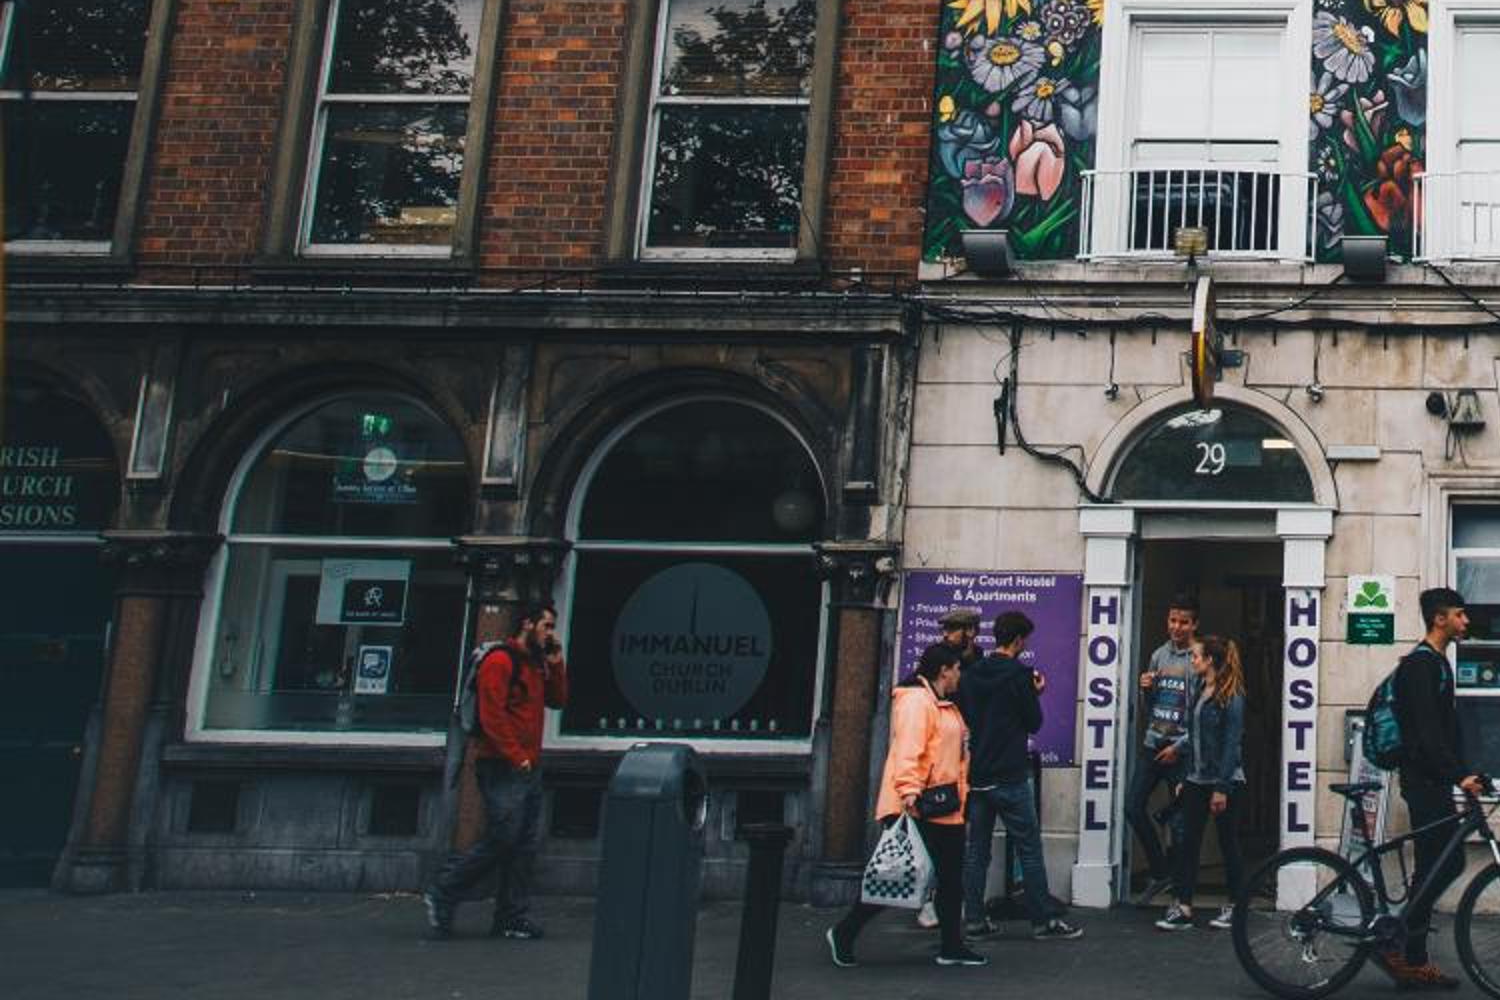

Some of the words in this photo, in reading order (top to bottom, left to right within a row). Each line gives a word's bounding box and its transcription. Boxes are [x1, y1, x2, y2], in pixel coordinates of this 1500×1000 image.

[1195, 442, 1226, 475] 29
[936, 574, 975, 588] Abbey
[979, 575, 1013, 587] Court
[1015, 575, 1056, 588] Hostel
[953, 590, 962, 601] &
[965, 589, 1036, 603] Apartments
[621, 634, 765, 657] IMMANUEL
[650, 662, 732, 677] CHURCH
[653, 679, 726, 695] DUBLIN
[1084, 595, 1118, 830] HOSTEL
[1287, 598, 1317, 832] HOSTEL
